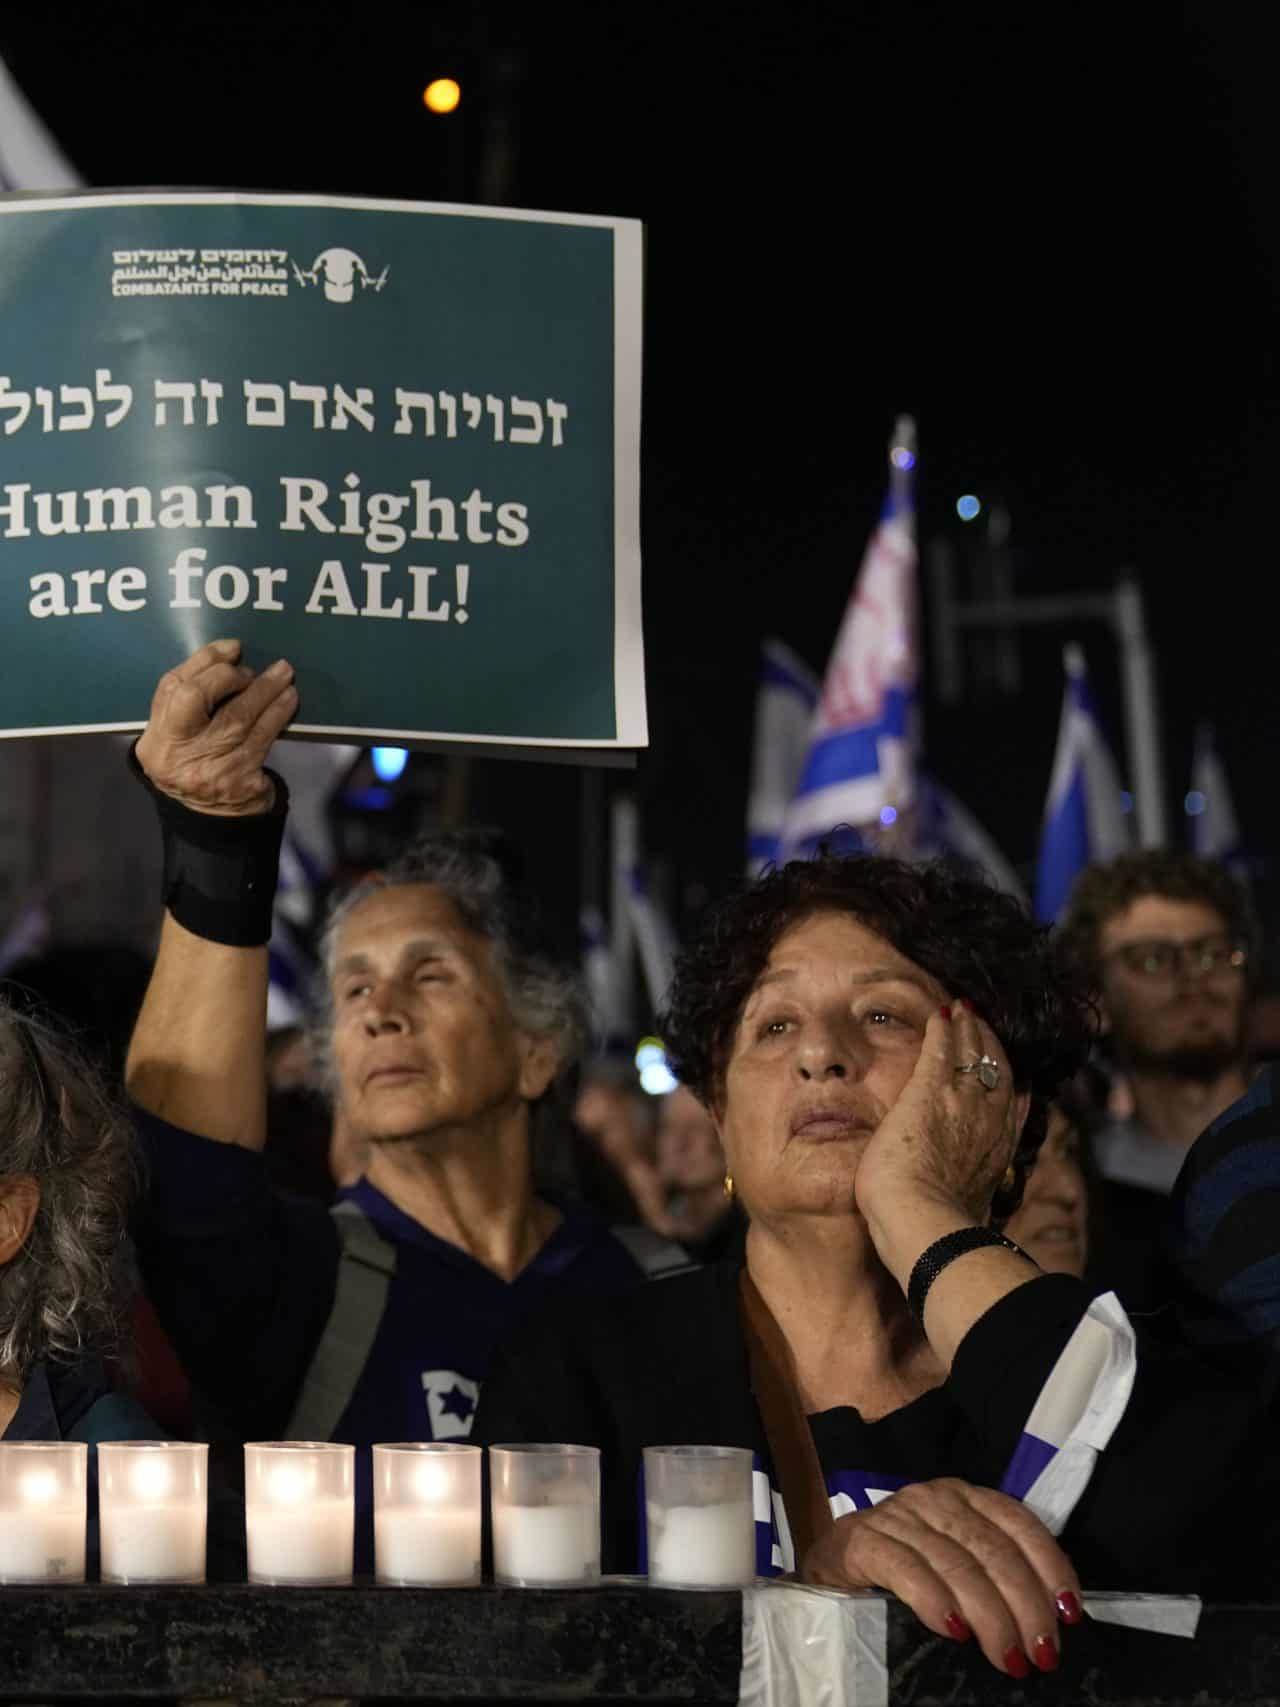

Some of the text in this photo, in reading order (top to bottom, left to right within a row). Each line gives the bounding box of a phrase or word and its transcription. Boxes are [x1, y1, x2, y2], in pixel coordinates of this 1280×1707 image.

[112, 249, 288, 264] לוחמים לשלום
[111, 283, 288, 297] COMBATANTS FOR PEACE
[155, 380, 224, 426] זה
[244, 380, 375, 432] אדם
[395, 389, 568, 446] זכויות
[280, 472, 529, 553] Rights
[29, 548, 469, 624] are for ALL!
